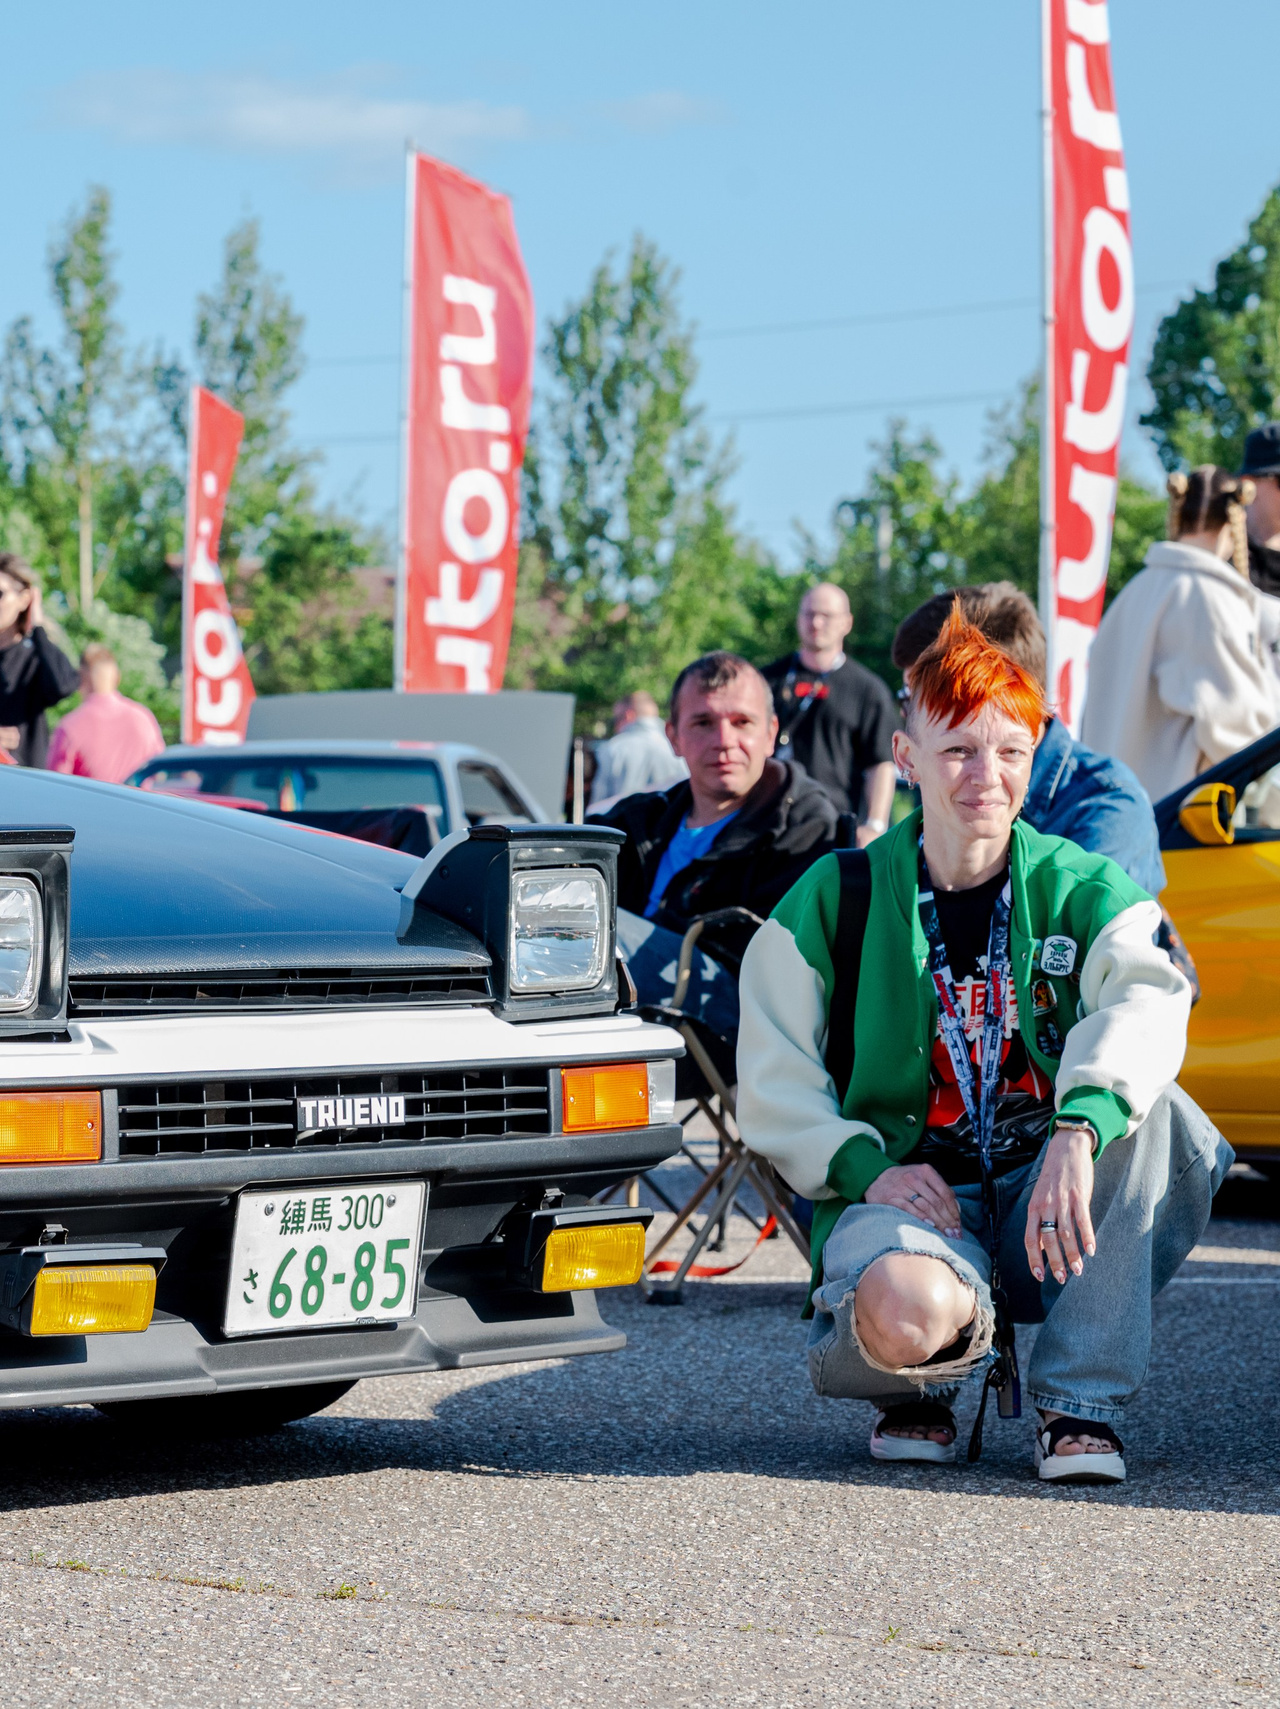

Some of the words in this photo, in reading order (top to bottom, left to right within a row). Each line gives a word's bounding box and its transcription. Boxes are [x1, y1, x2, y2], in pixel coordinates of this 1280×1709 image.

[300, 1096, 405, 1128] TRUENO
[279, 1197, 332, 1235] 練馬
[337, 1193, 384, 1231] 300
[243, 1268, 259, 1304] さ
[268, 1238, 411, 1318] 68-85
[357, 1317, 378, 1325] TOYOTA
